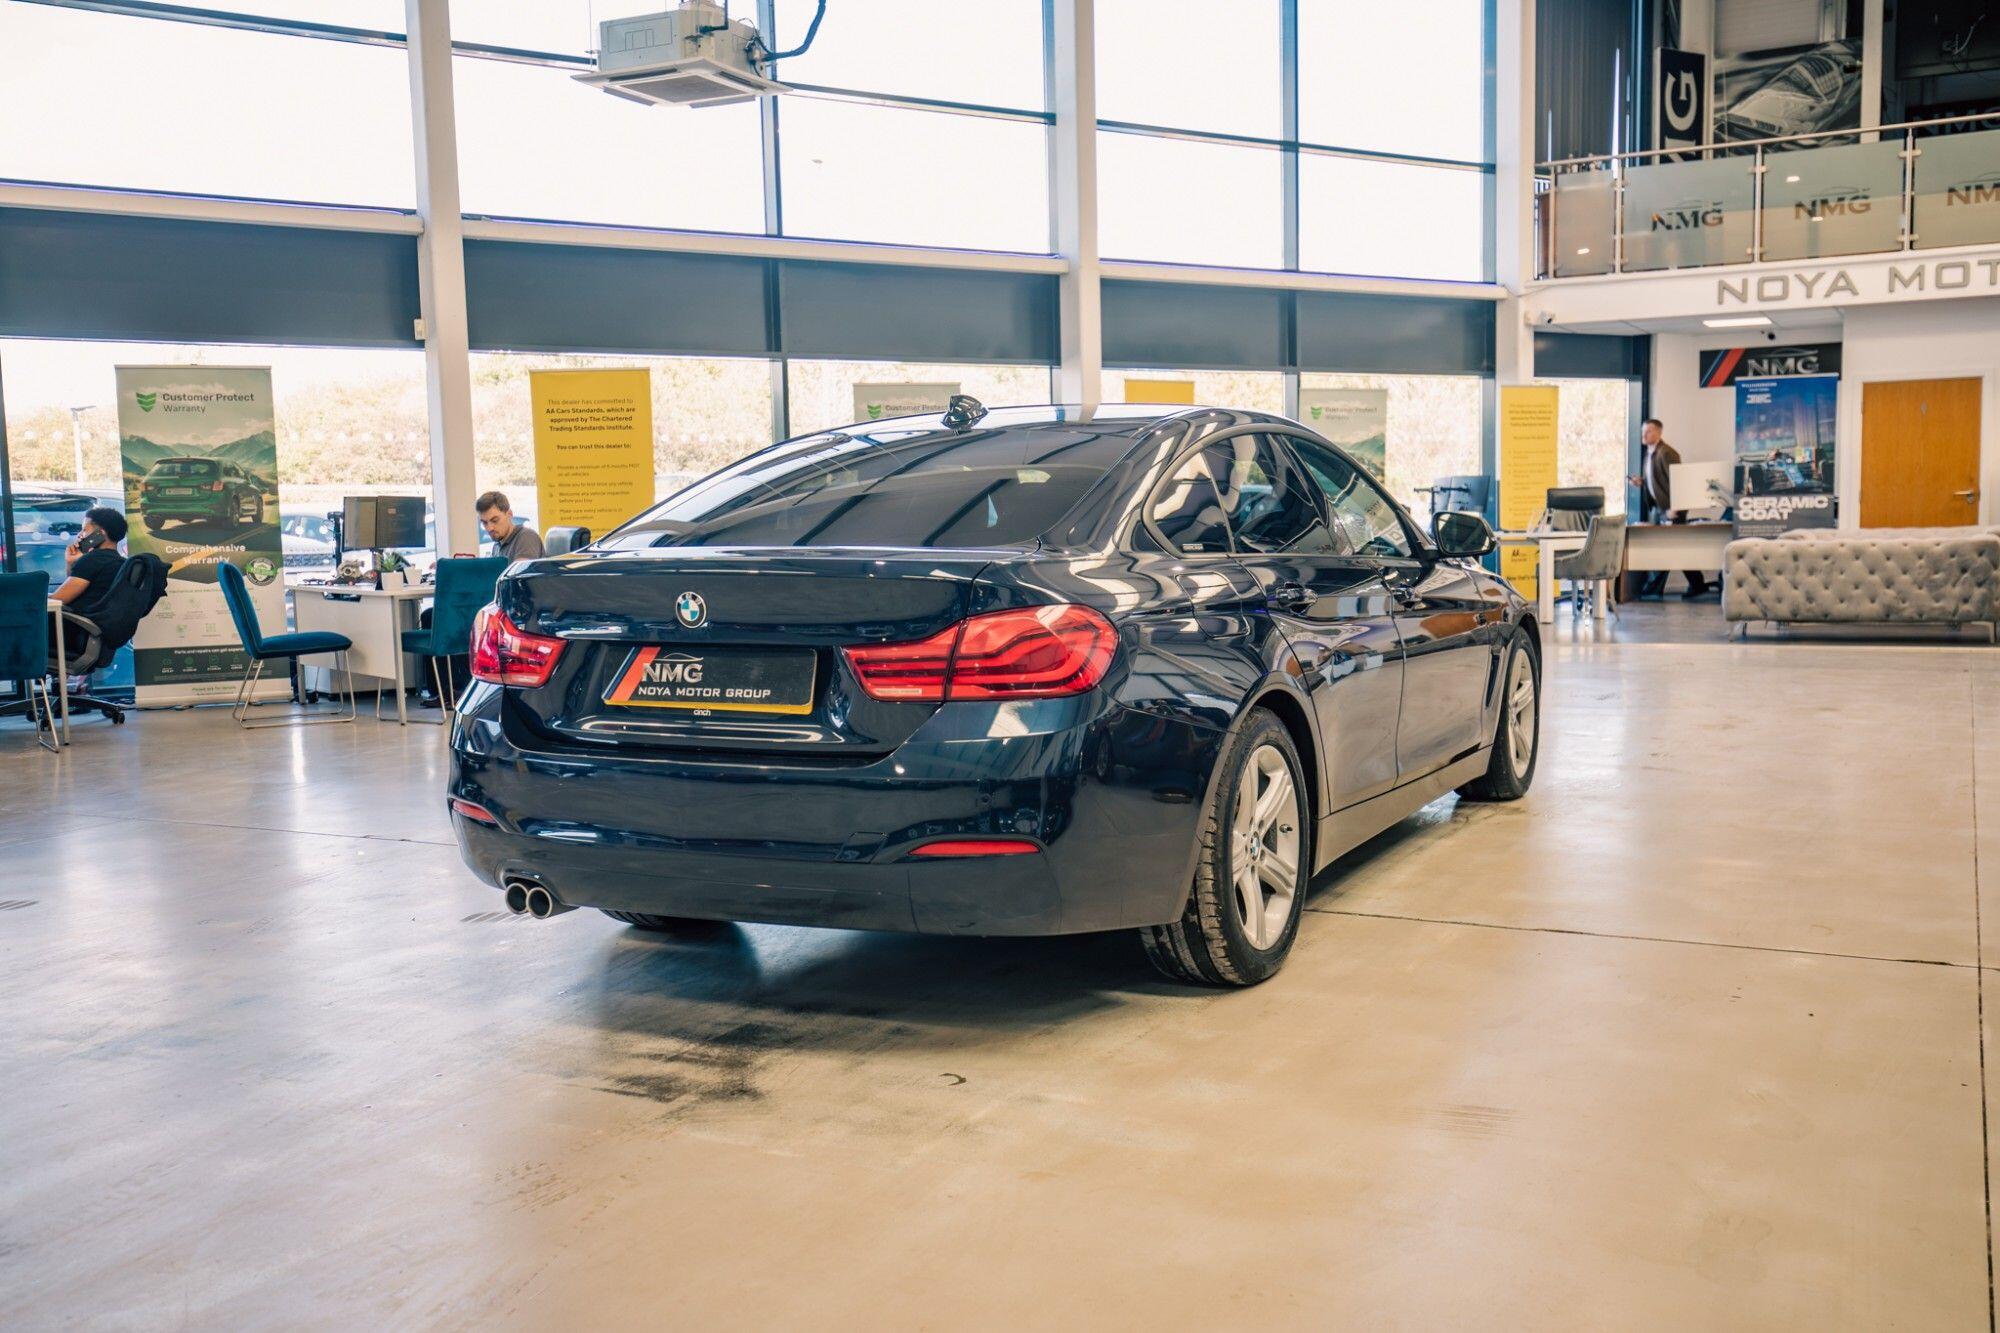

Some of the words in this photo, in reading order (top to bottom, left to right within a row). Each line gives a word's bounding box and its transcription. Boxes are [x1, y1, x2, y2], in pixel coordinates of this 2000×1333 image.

[1794, 195, 1872, 220] NMG
[1651, 207, 1724, 232] NMG
[1717, 270, 1860, 305] NOYA
[1888, 259, 2000, 293] MOT
[1747, 355, 1819, 377] NMG
[162, 393, 214, 401] Customer
[216, 393, 255, 401] Protect
[163, 404, 206, 413] Warranty
[1738, 495, 1829, 510] CERAMIC
[1738, 508, 1793, 521] COAT
[165, 544, 246, 554] Comprehensive
[641, 663, 704, 683] NMG
[638, 686, 671, 697] NOYA
[676, 687, 720, 698] MOTOR
[725, 688, 771, 699] GROUP
[693, 708, 711, 717] cinch
